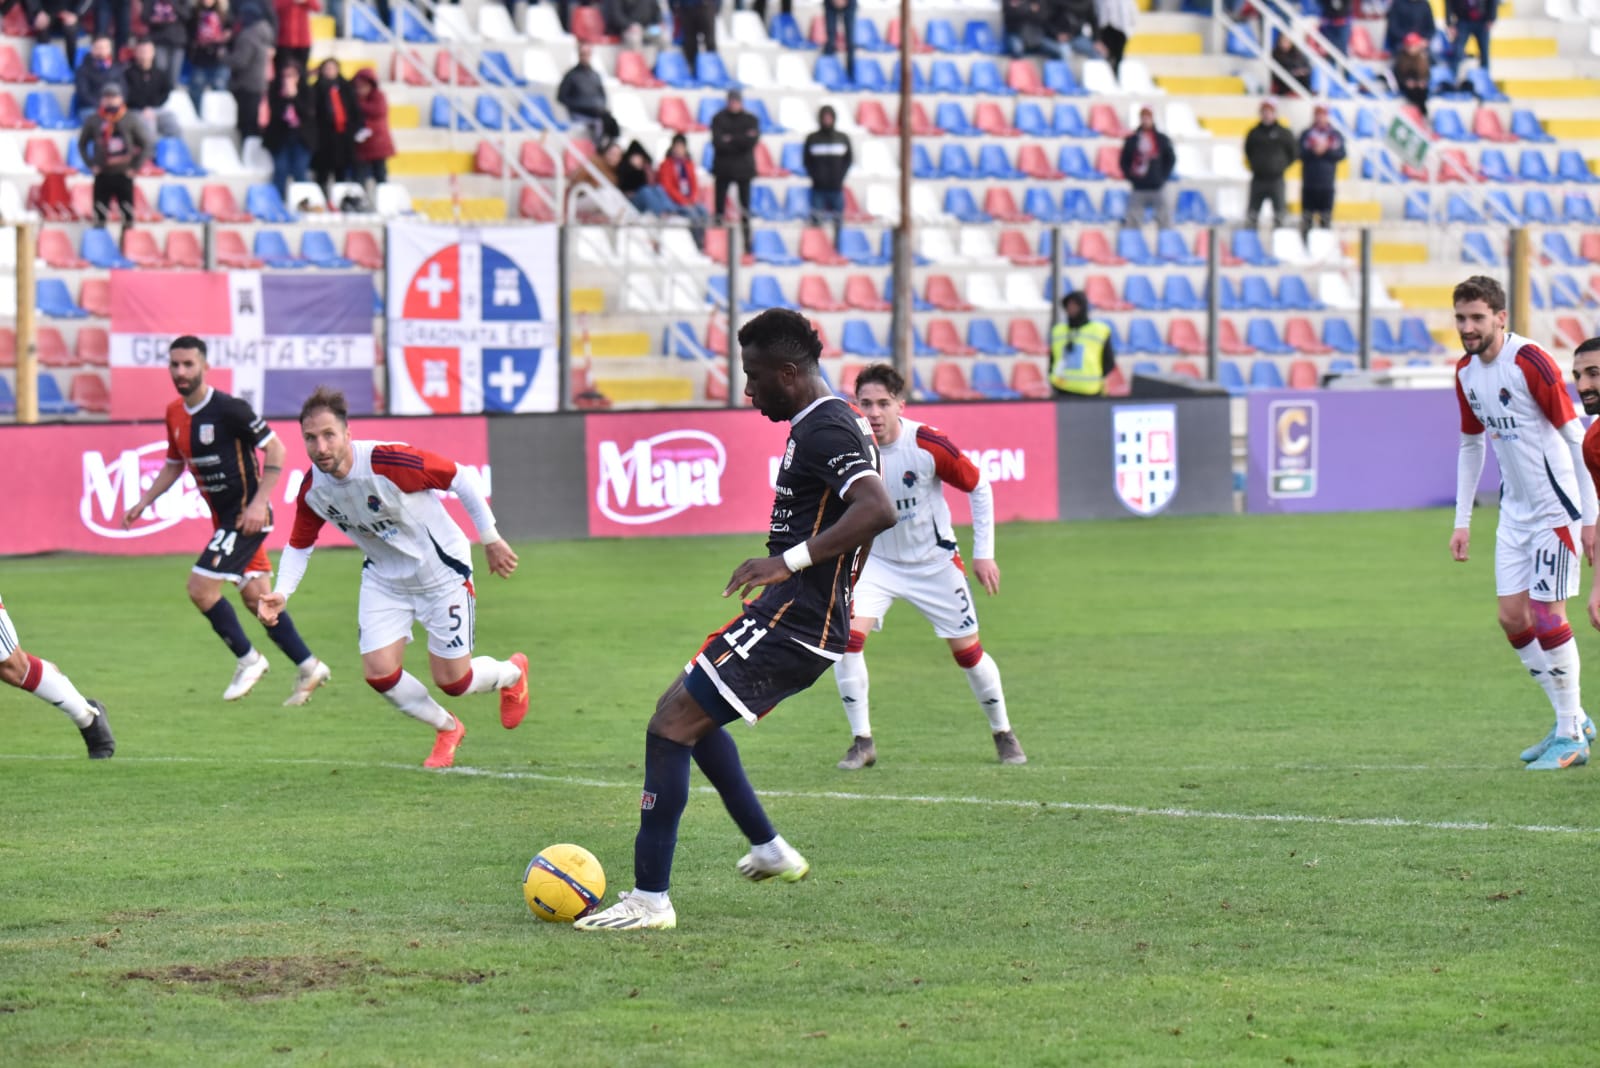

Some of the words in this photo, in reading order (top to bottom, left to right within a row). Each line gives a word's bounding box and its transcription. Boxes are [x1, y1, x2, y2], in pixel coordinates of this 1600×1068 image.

[132, 336, 294, 366] GRINATA
[1277, 408, 1309, 457] C
[599, 439, 722, 508] Mara
[208, 529, 238, 556] 24
[1535, 548, 1556, 576] 14
[954, 587, 969, 614] 3
[448, 604, 462, 632] 5
[723, 618, 768, 660] 11
